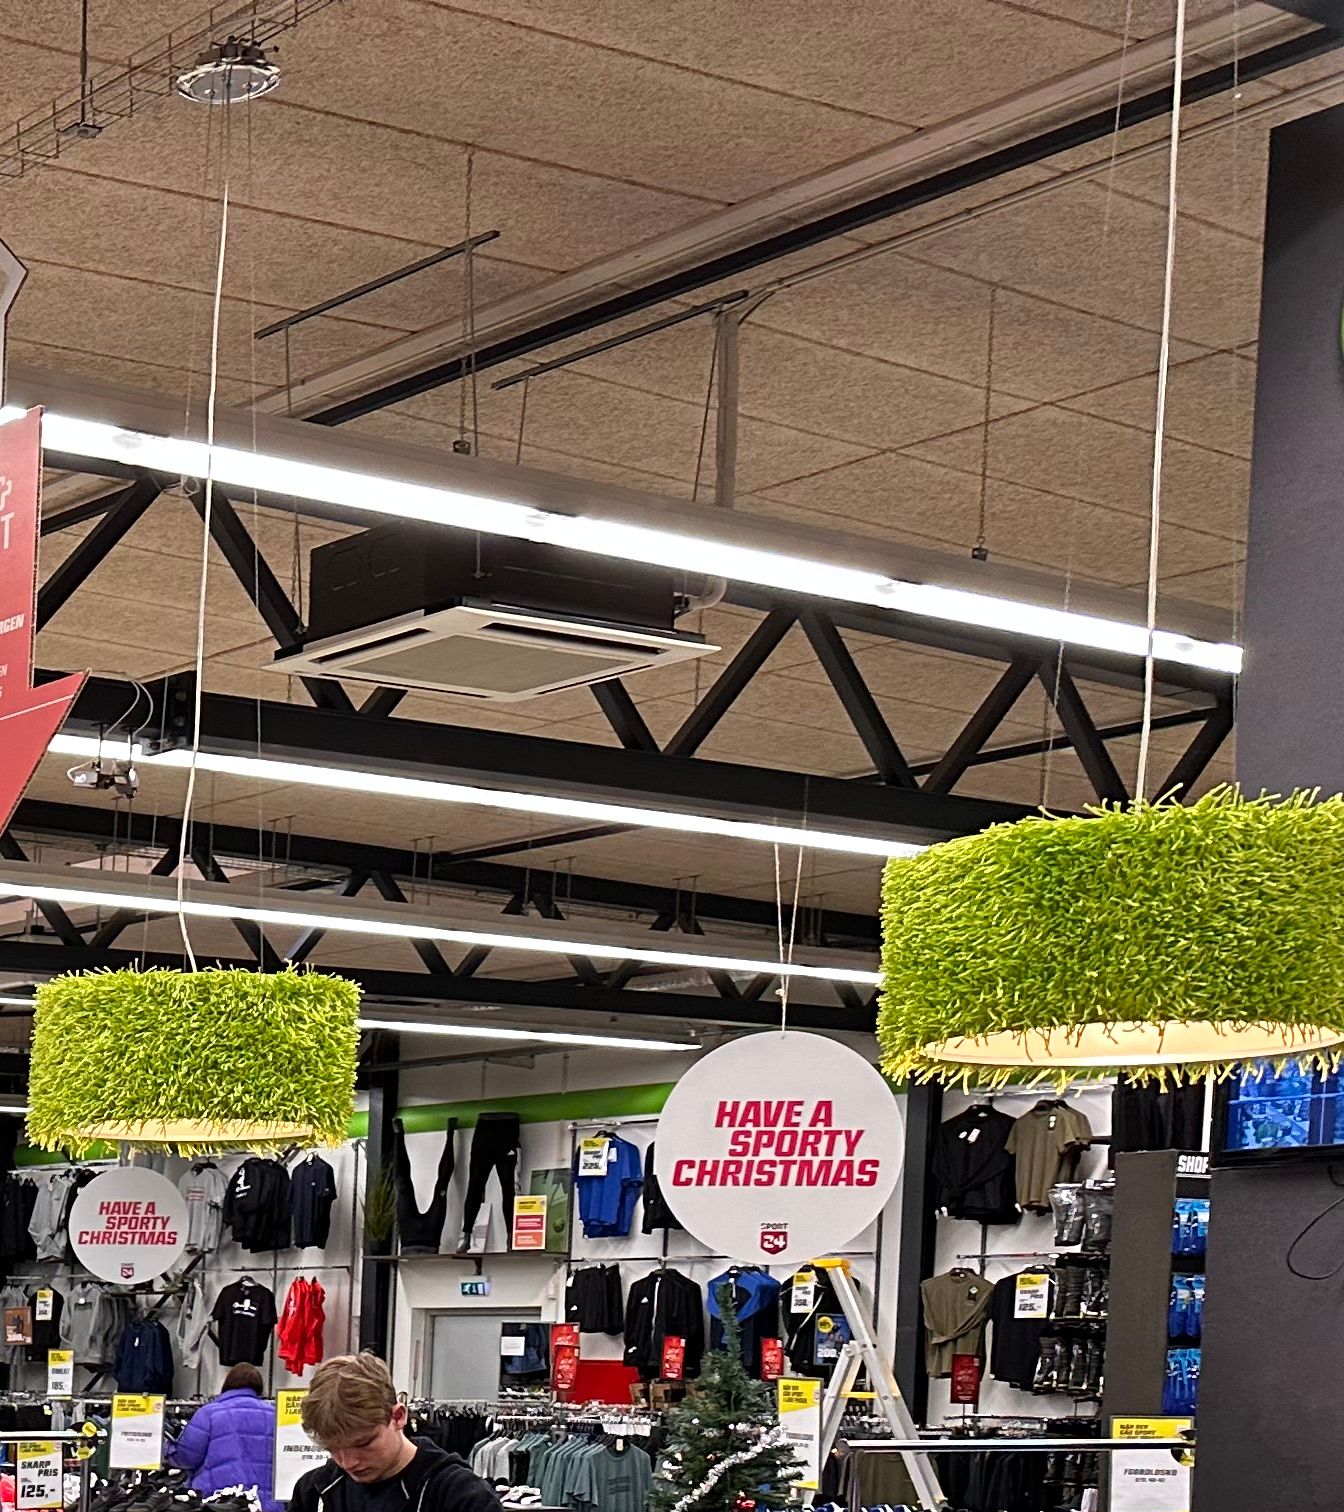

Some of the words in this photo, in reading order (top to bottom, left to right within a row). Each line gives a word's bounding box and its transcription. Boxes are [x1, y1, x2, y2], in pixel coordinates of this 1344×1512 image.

[715, 1100, 804, 1128] HAVE
[809, 1100, 833, 1128] A
[729, 1129, 865, 1157] SPORTY
[673, 1160, 880, 1187] CHRISTMAS
[99, 1201, 142, 1215] HAVE
[144, 1201, 156, 1215] A
[105, 1216, 170, 1230] SPORTY
[78, 1231, 178, 1245] CHRISTMAS
[762, 1234, 786, 1248] 24
[21, 1461, 51, 1470] SKARP
[37, 1469, 59, 1477] PRIS
[21, 1485, 55, 1499] 125,-
